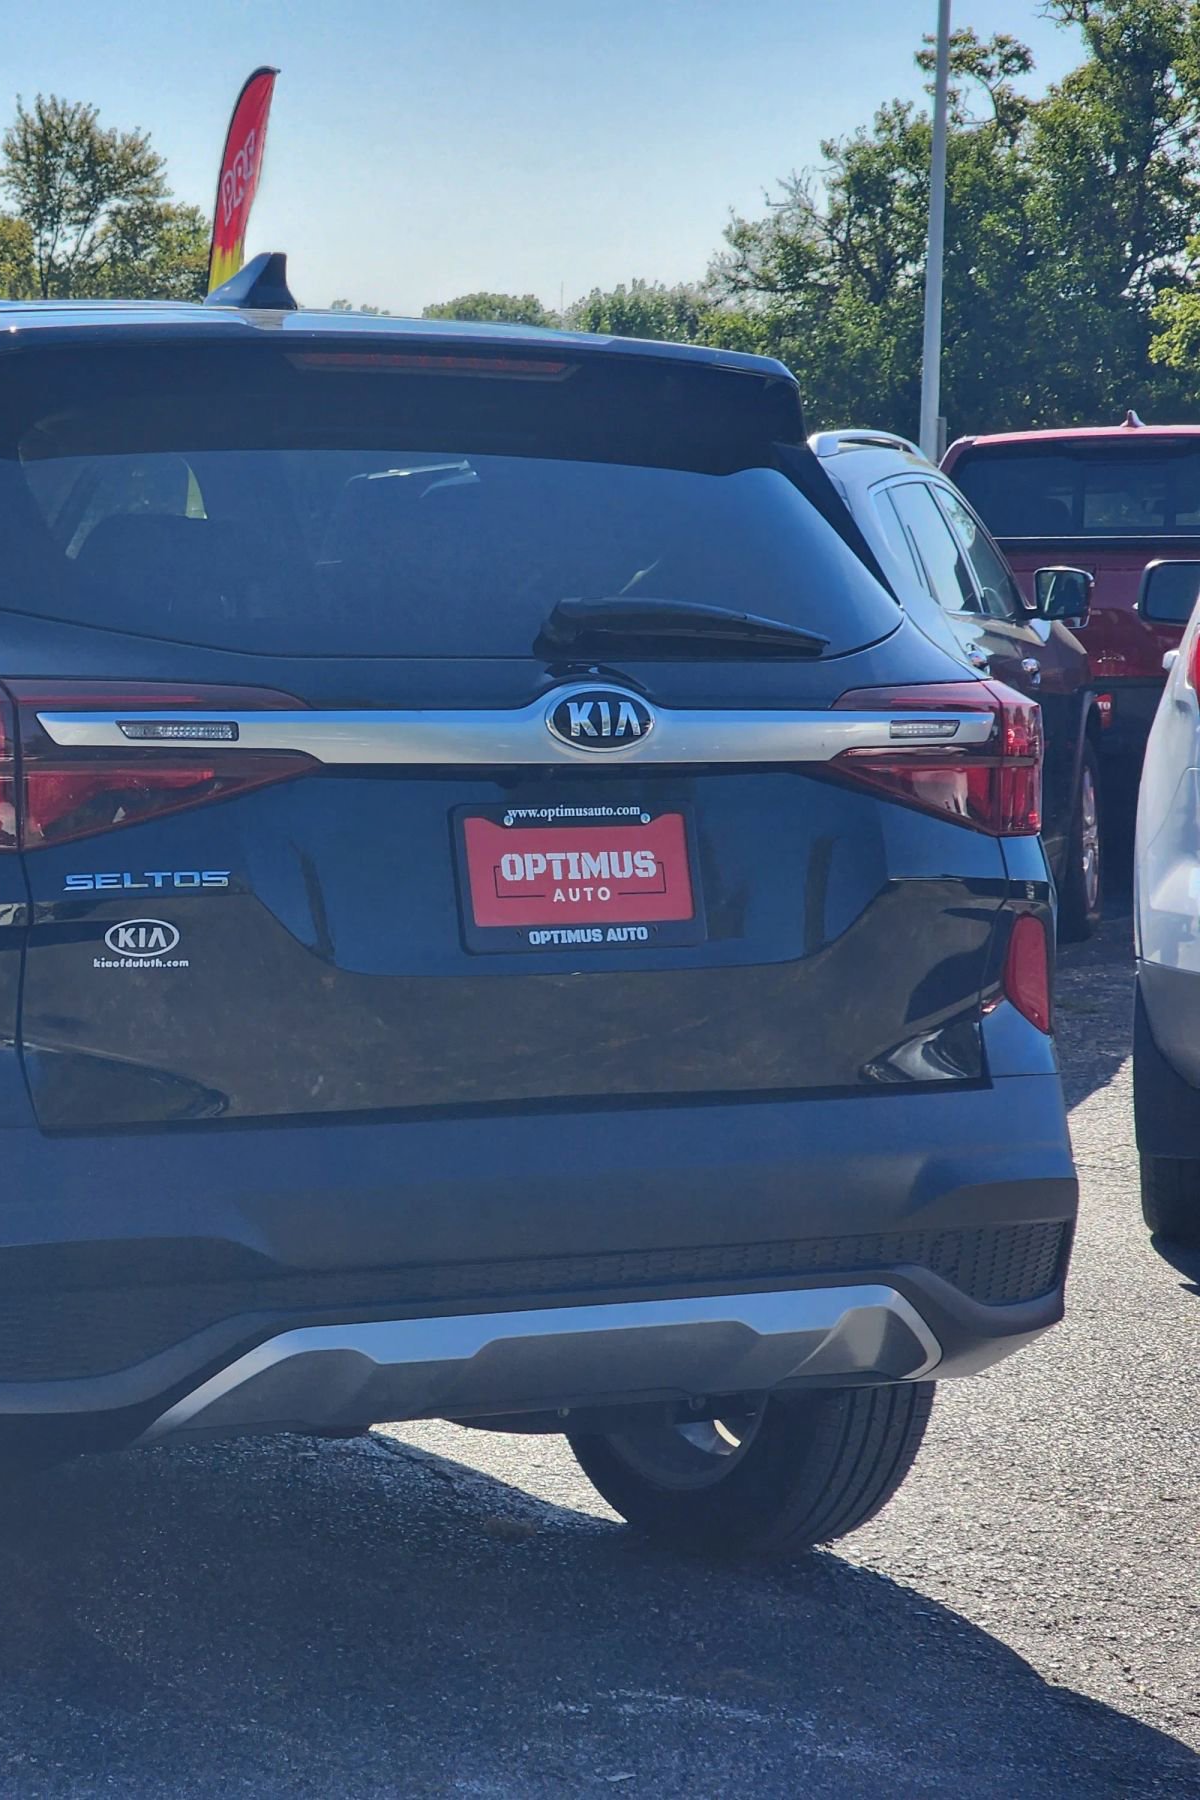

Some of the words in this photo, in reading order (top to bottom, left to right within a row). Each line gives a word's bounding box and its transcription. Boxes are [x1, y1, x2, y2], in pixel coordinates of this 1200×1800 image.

[566, 701, 641, 736] KIA
[506, 804, 640, 821] www.optimusauto.com
[500, 851, 657, 881] OPTIMUS
[63, 871, 231, 891] SELTOS
[553, 887, 611, 902] AUTO
[117, 927, 167, 948] KIA
[528, 928, 603, 945] OPTIMUS
[606, 926, 648, 942] AUTO
[93, 957, 189, 969] kiaofduluth.com
